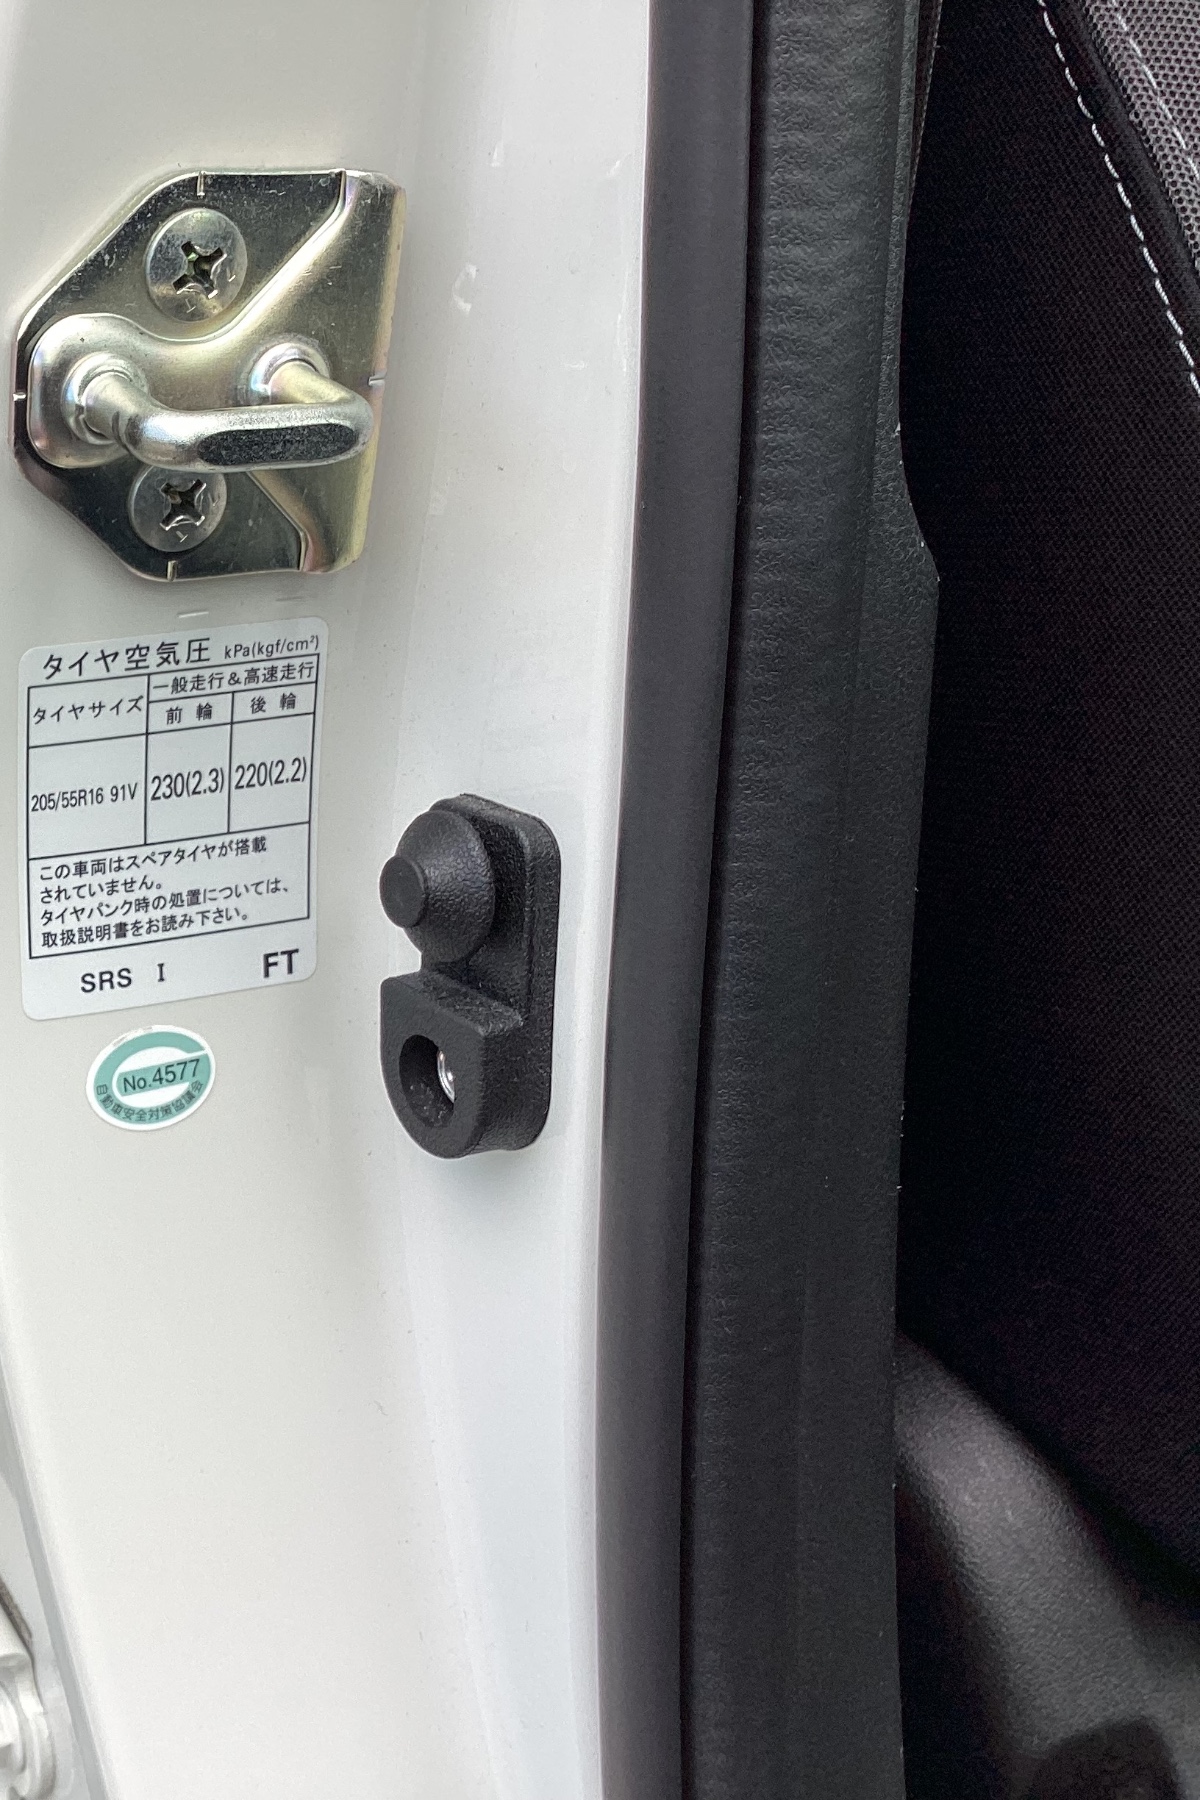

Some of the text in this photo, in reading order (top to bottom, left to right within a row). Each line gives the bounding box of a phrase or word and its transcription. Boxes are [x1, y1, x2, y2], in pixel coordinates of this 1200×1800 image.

[43, 637, 210, 680] タイヤ空気圧
[32, 695, 143, 725] タイヤサイズ
[151, 767, 225, 802] 230(2.3)
[234, 756, 307, 791] 220(2.2)
[31, 782, 138, 812] 205/55R16 91V
[40, 836, 267, 881] この車両はスペアタイヤが搭載
[40, 874, 163, 904] されていません。
[40, 877, 289, 926] タイヤパンク時の処置については、
[41, 905, 247, 949] 取扱説明書をお読み下さい。
[80, 968, 133, 993] SRS
[263, 948, 299, 978] FT
[123, 1058, 200, 1093] No.4577
